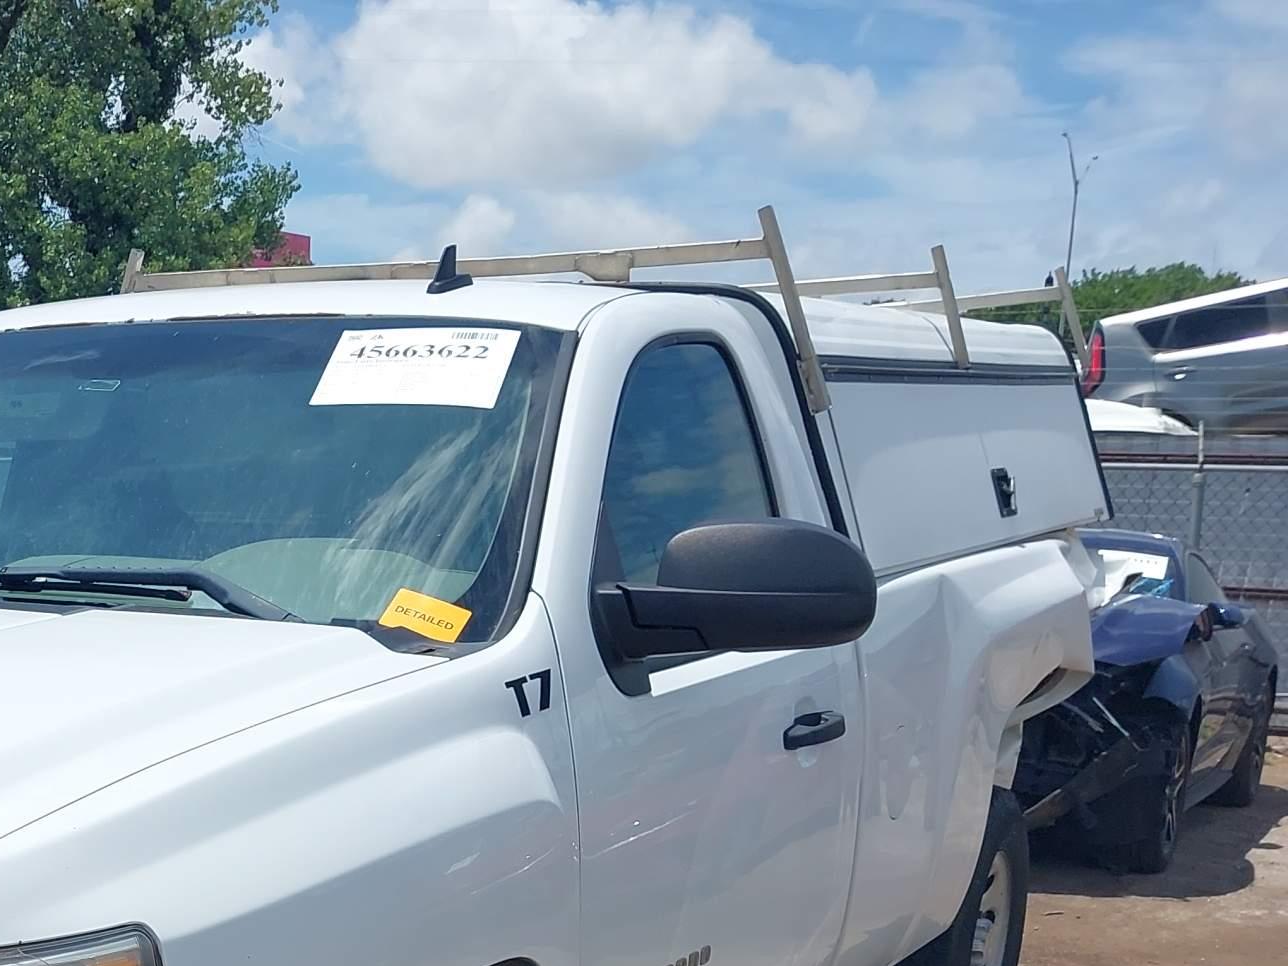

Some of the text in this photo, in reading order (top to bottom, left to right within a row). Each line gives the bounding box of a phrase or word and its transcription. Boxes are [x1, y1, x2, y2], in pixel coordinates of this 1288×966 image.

[349, 344, 490, 360] 45663622
[394, 604, 454, 631] DETAILED
[504, 668, 552, 718] T7
